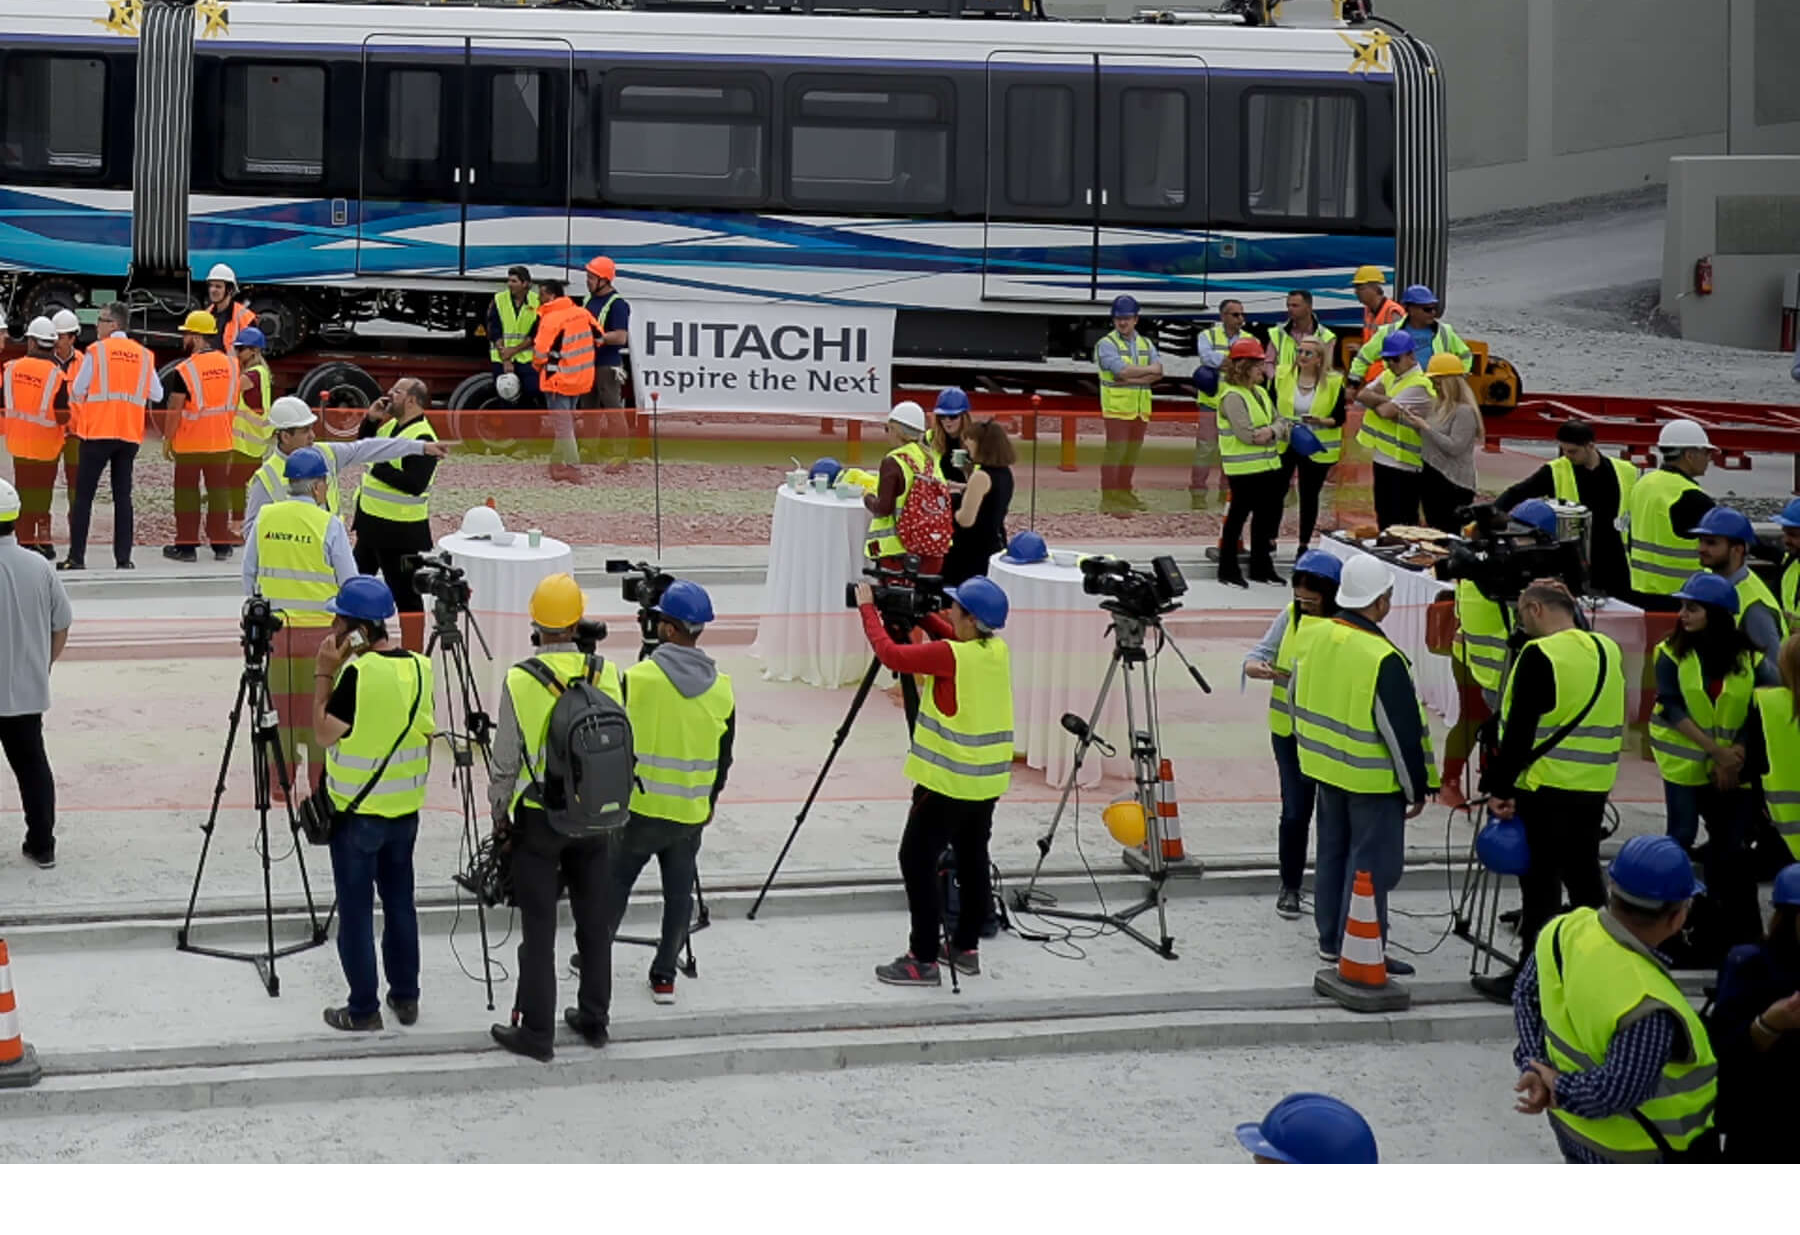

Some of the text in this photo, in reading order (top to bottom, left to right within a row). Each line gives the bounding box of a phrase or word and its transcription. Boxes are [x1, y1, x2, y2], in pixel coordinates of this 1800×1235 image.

[645, 321, 868, 363] HITACHI
[747, 367, 797, 391] the
[806, 366, 881, 394] Next
